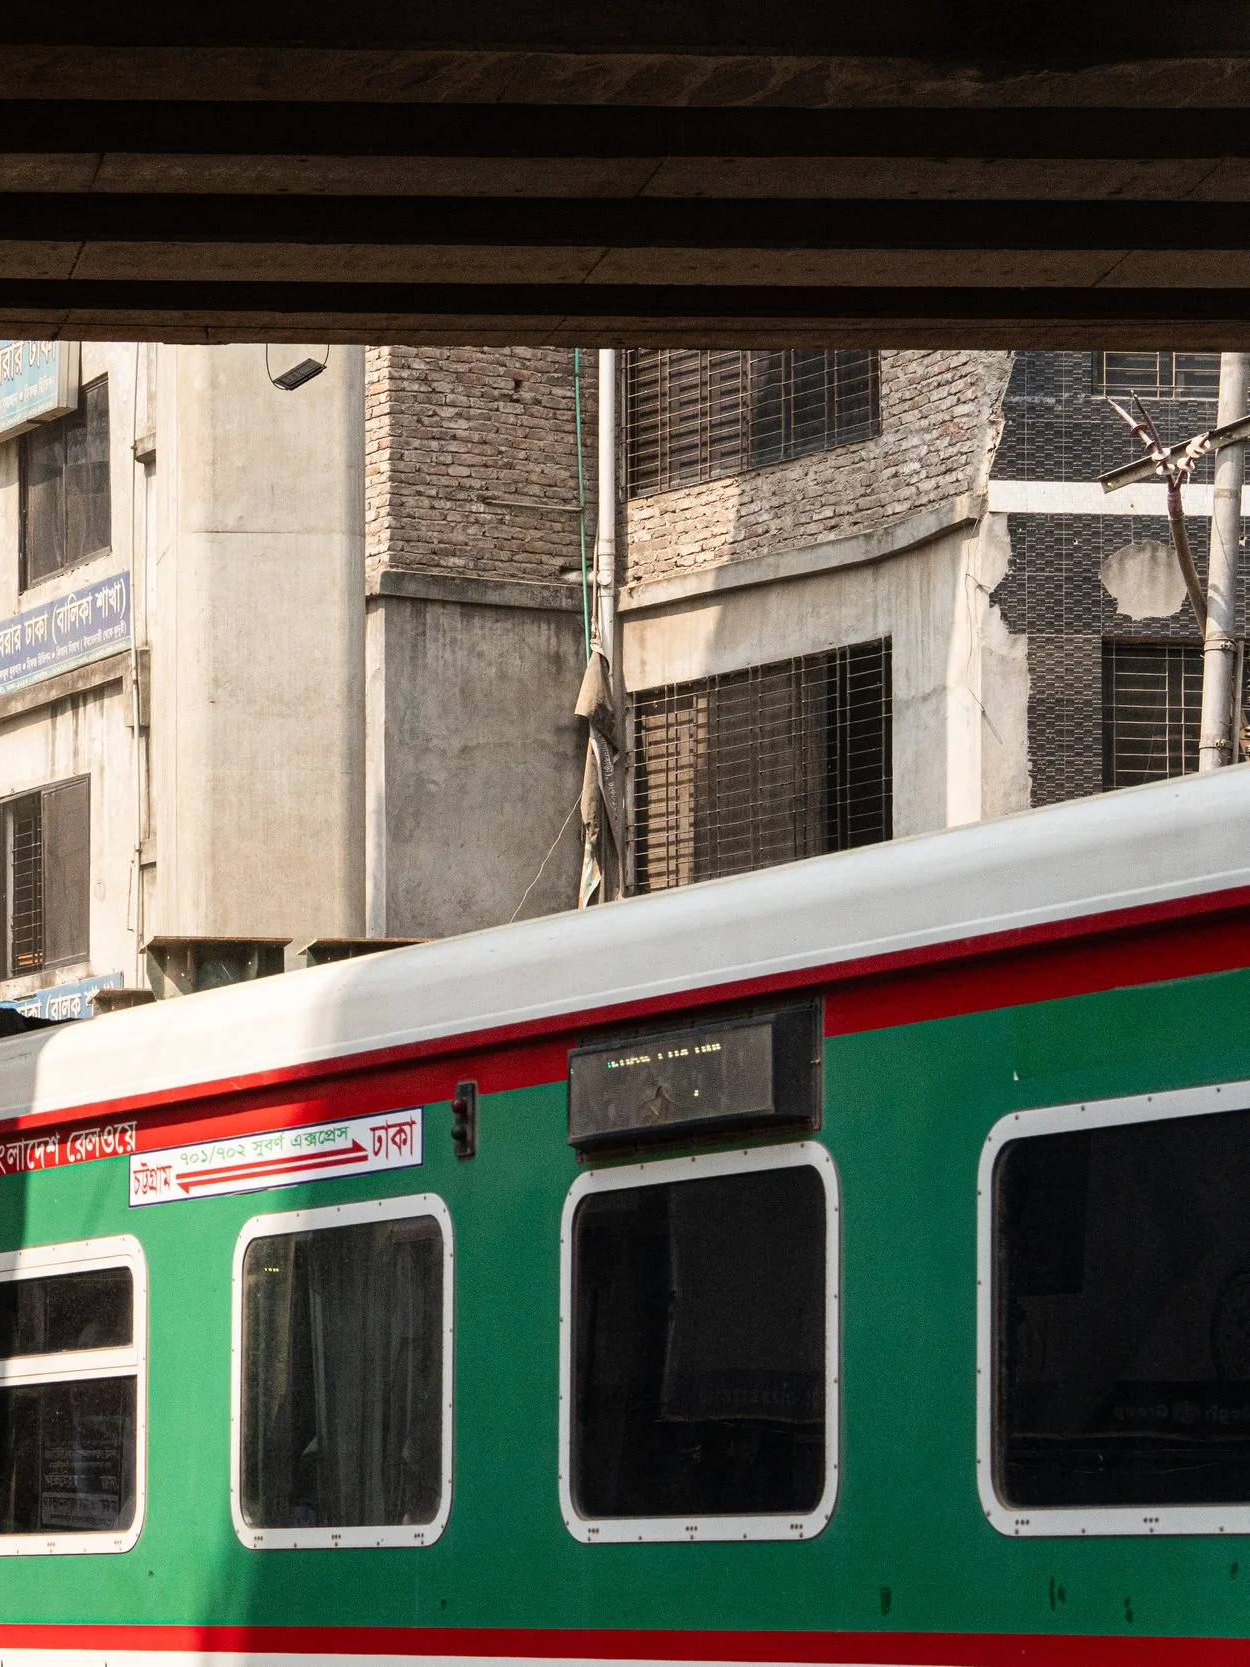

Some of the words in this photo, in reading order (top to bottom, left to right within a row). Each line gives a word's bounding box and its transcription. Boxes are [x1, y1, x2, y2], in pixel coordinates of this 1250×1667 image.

[23, 610, 49, 648] ঢাকা
[52, 592, 93, 644] (বালিকা
[96, 577, 127, 620] শাখা)
[66, 1120, 138, 1163] রেলওয়ে
[180, 1142, 246, 1166] ৭০১/৭০২
[251, 1131, 285, 1157] সুবর্ণ
[290, 1125, 350, 1147] এক্সপ্রেস
[368, 1116, 416, 1159] ঢাকা
[132, 1158, 172, 1196] চট্টগ্রাম
